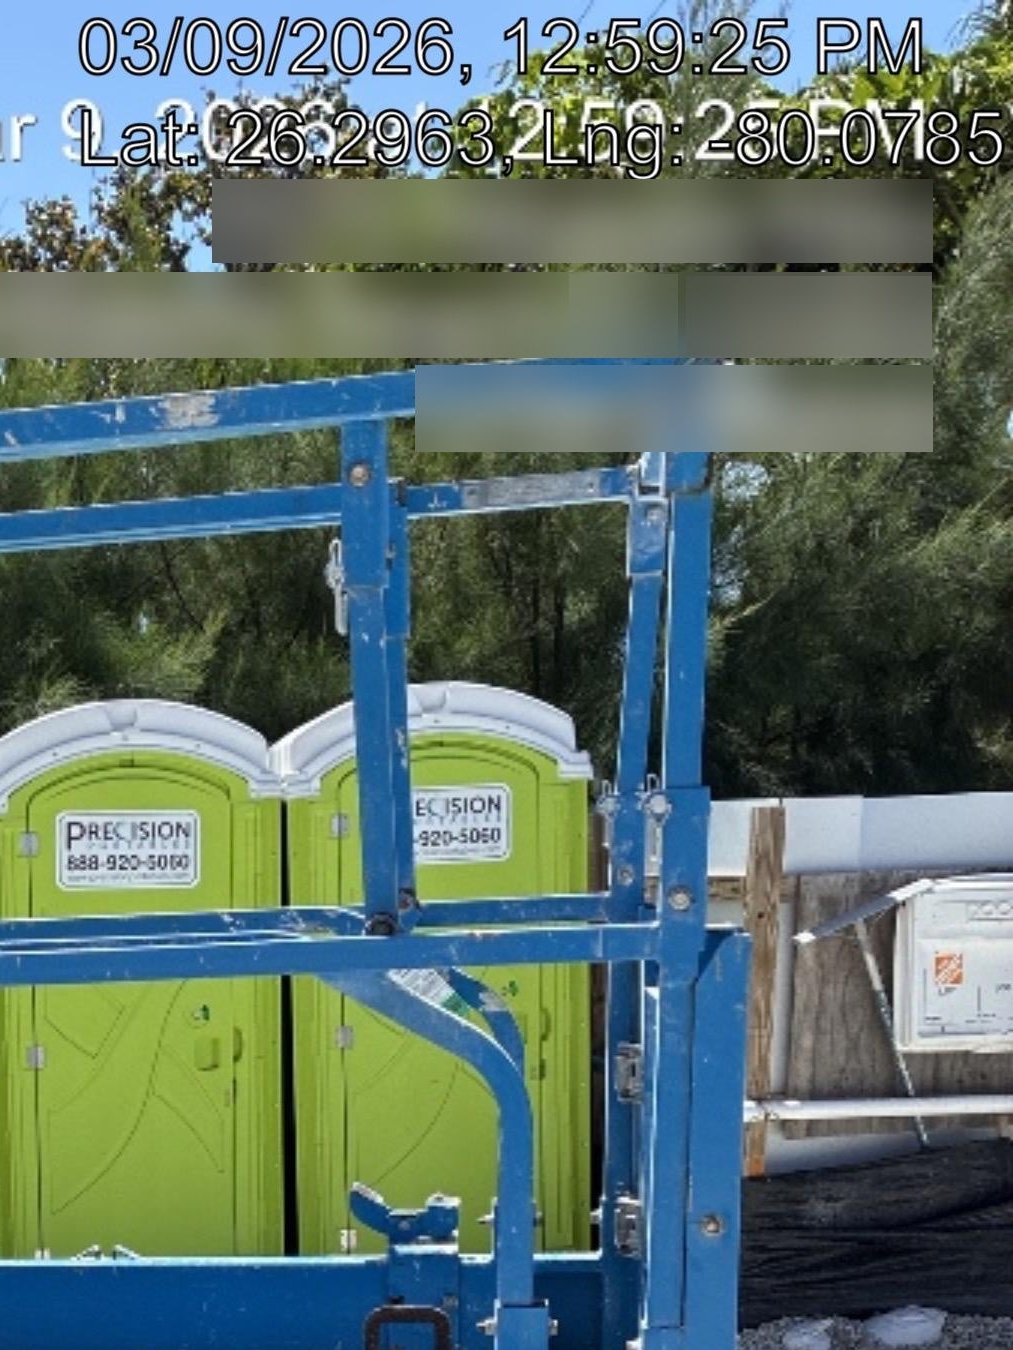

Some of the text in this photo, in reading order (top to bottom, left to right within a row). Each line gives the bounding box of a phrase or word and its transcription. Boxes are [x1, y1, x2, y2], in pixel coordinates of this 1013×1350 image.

[415, 795, 502, 818] ECISION
[67, 821, 191, 851] PRECISION
[413, 827, 502, 847] -920-5060
